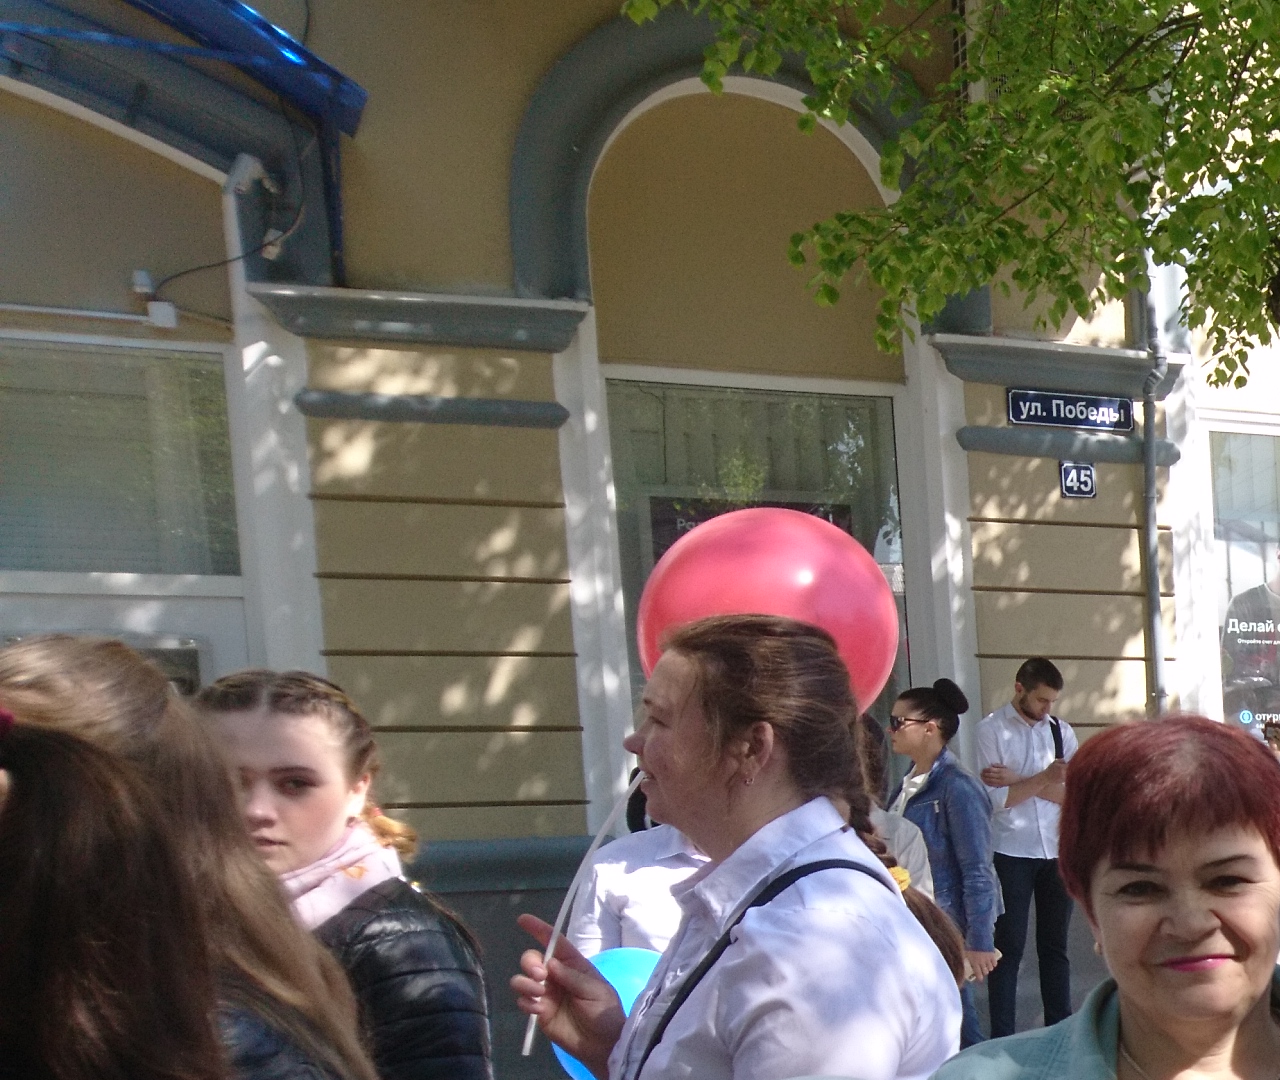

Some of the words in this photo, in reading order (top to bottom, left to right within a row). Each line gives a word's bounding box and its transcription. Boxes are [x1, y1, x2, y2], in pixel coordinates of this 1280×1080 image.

[1019, 401, 1046, 419] ул.
[1052, 400, 1124, 424] Победы
[1066, 468, 1092, 492] 45
[1227, 619, 1274, 633] Делай
